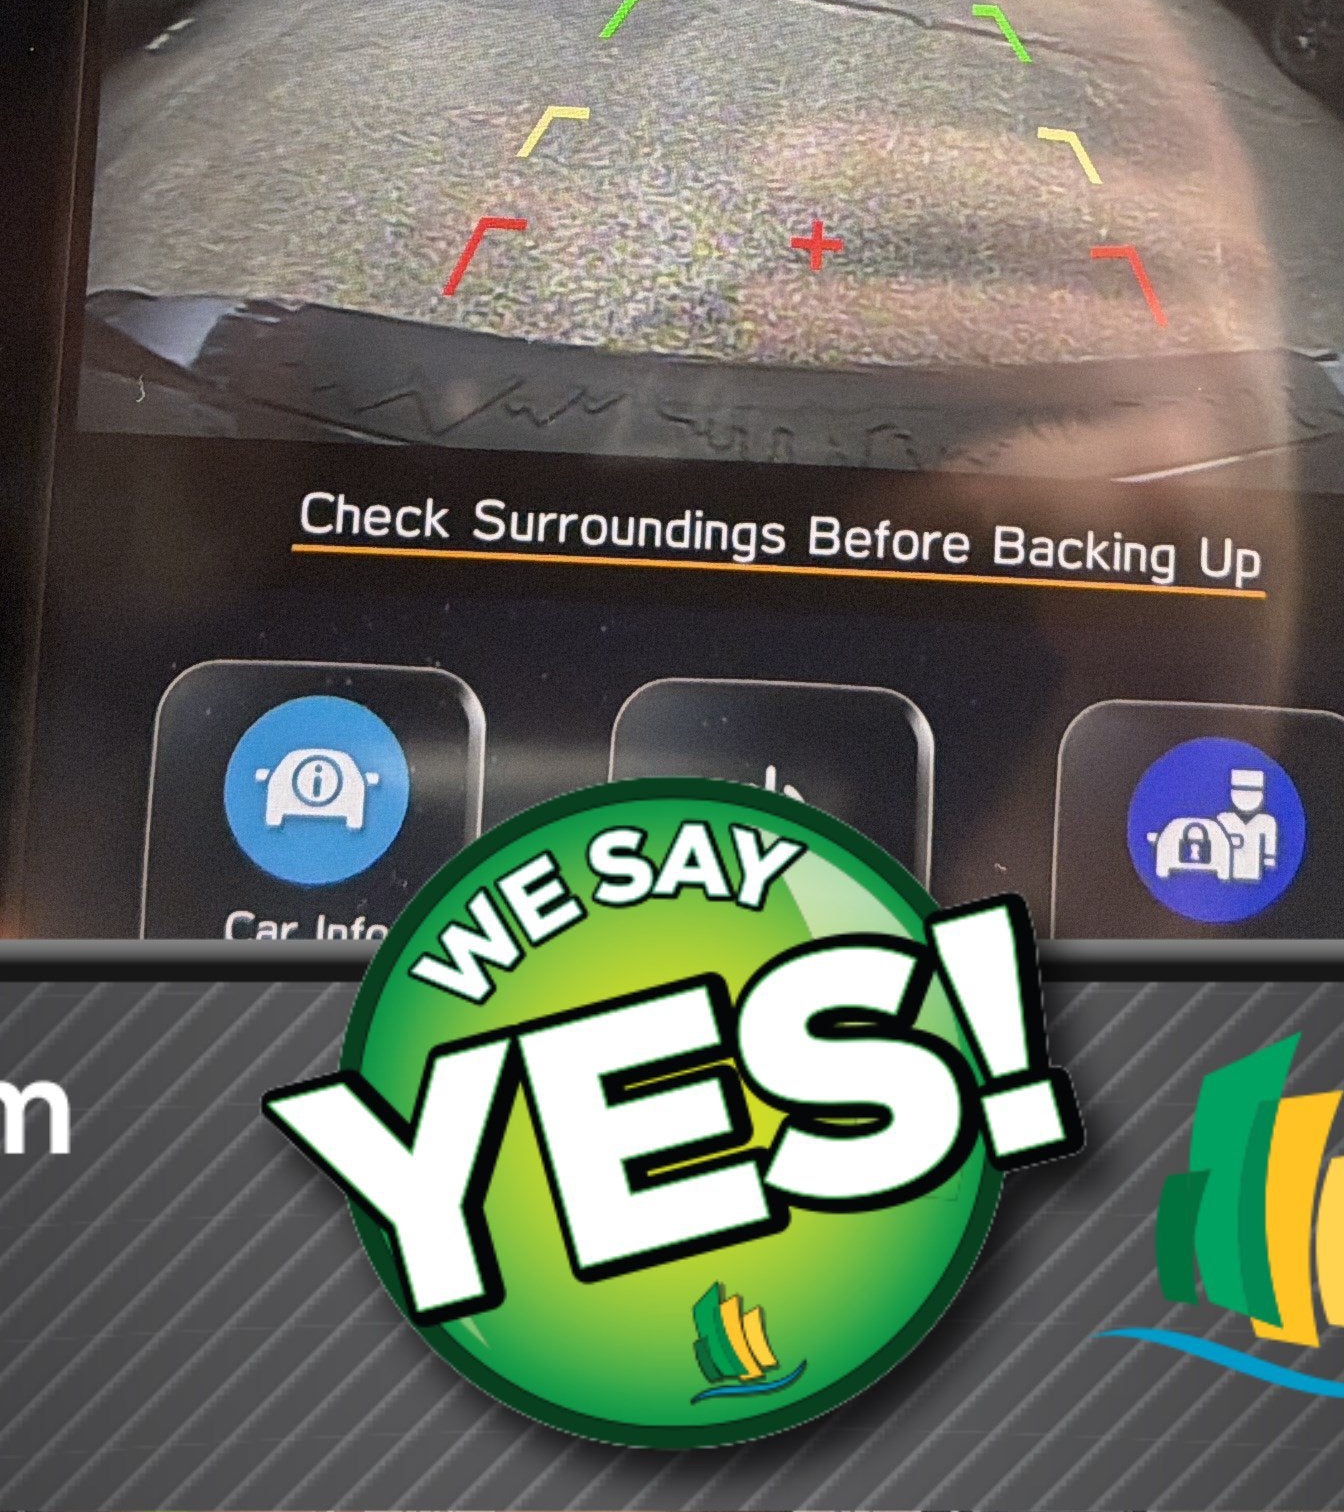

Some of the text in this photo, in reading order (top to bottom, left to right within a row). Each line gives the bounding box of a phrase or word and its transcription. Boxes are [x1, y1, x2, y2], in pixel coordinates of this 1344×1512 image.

[299, 491, 1262, 588] Check Surroundings Before Backing Up
[224, 910, 299, 940] Car
